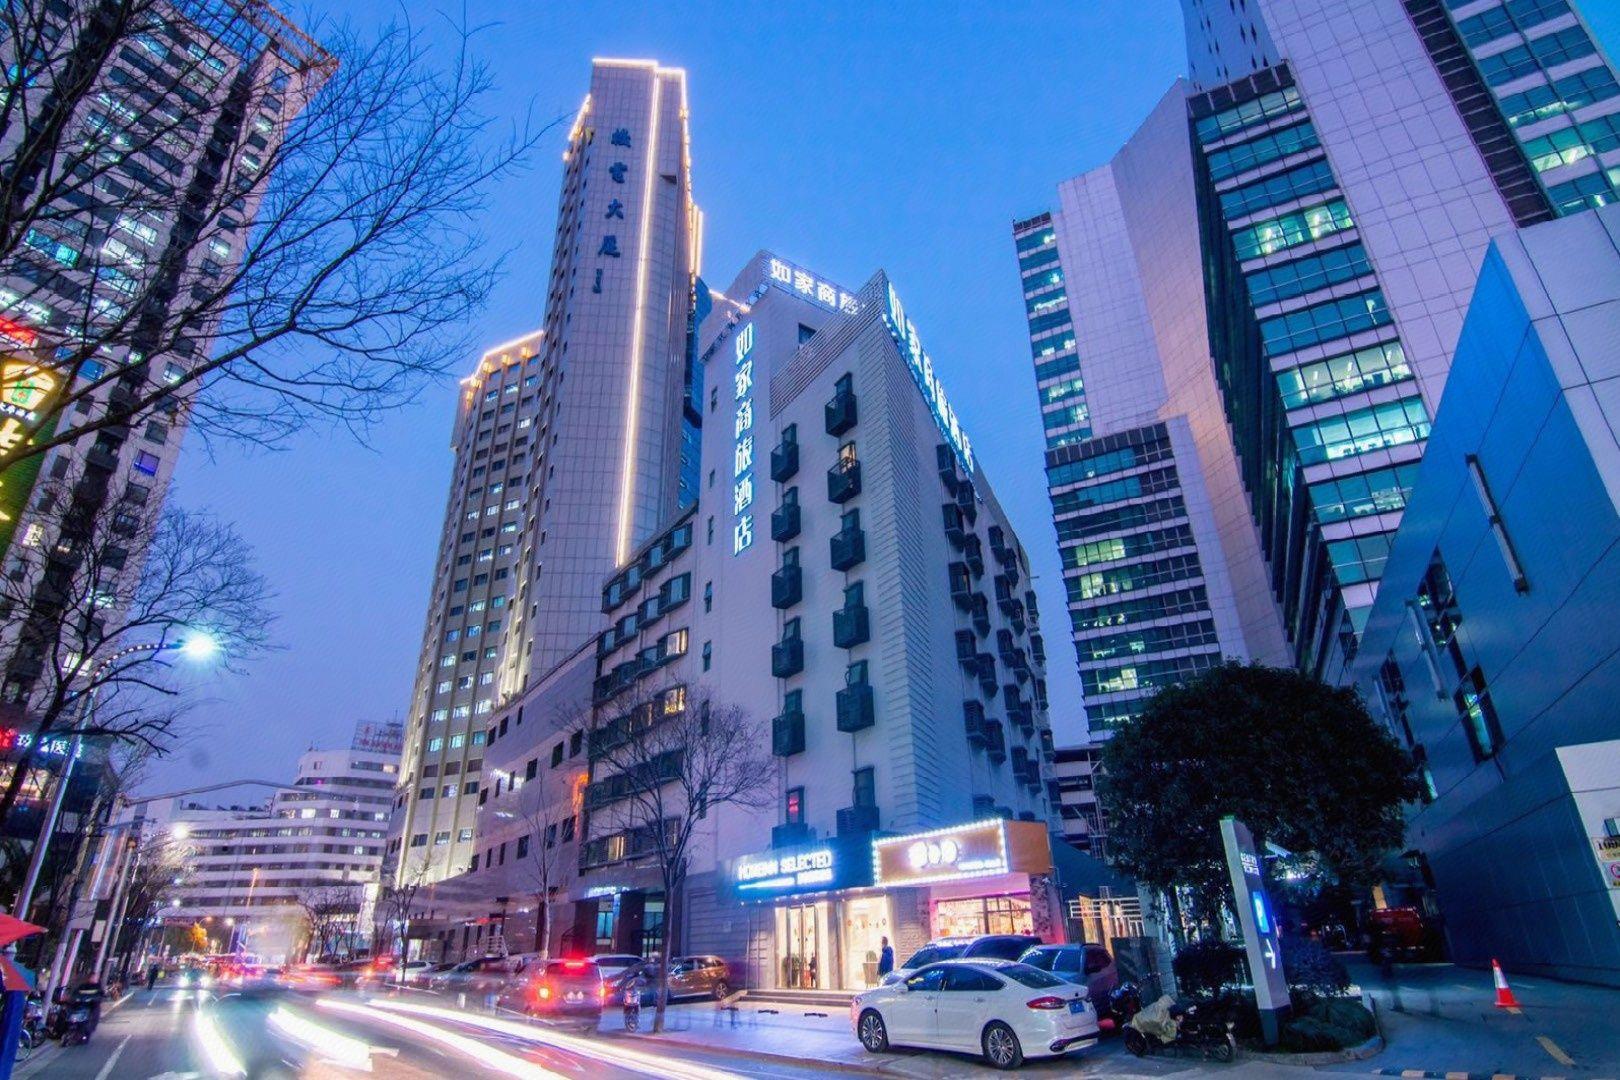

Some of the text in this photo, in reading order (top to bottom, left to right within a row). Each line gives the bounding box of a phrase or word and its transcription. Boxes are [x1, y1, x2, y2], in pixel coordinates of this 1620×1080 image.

[735, 322, 753, 555] 如家商旅酒店
